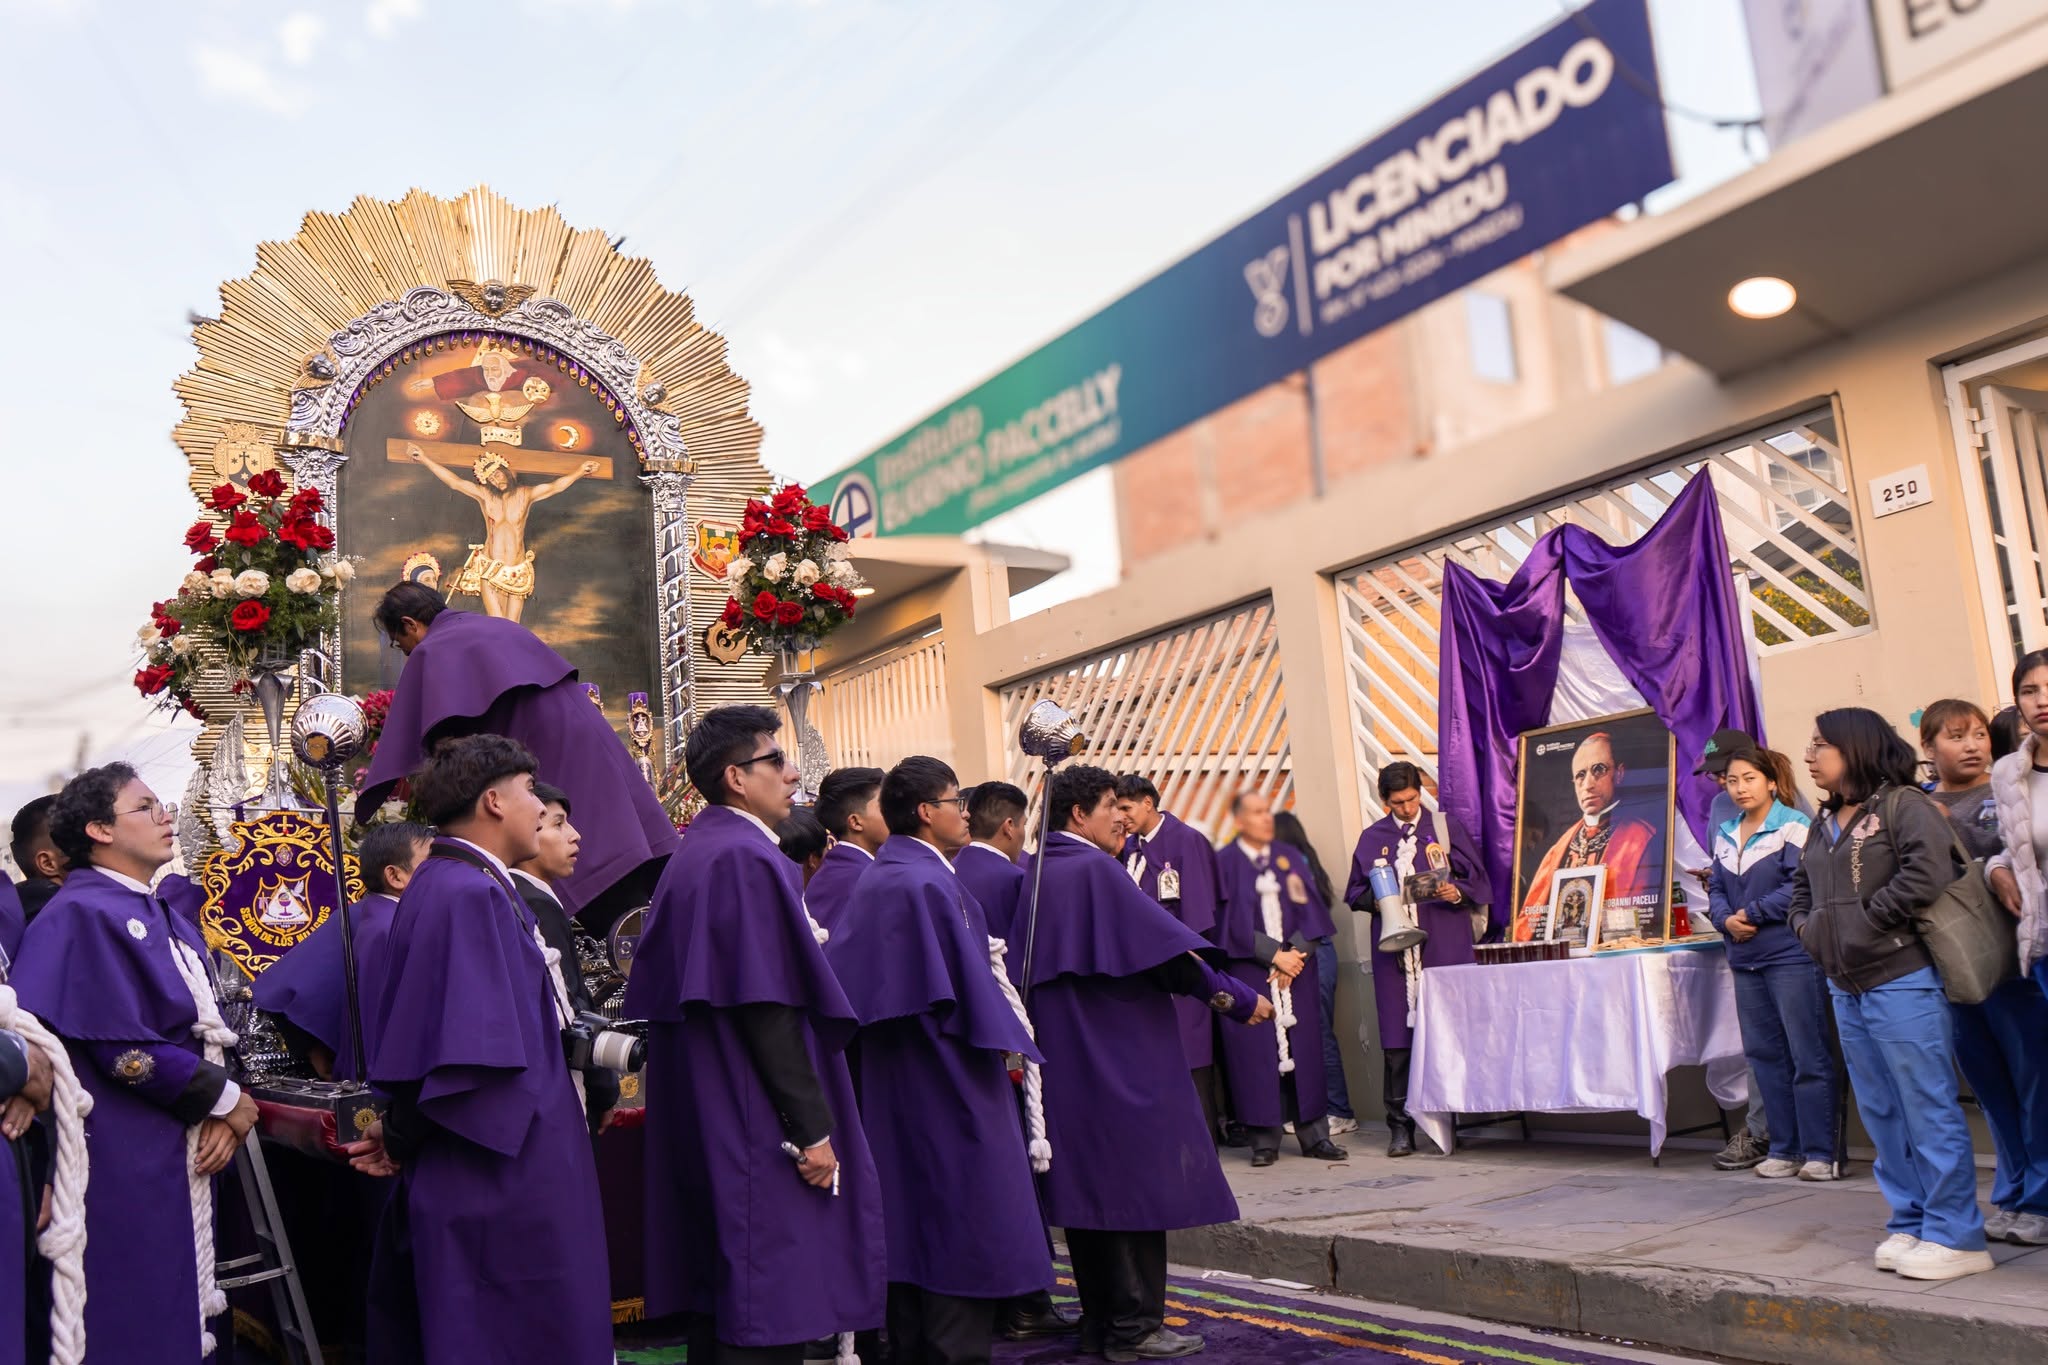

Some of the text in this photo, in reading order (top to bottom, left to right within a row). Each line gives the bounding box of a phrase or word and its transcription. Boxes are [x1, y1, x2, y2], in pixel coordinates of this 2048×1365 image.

[1308, 38, 1614, 255] LICENCIADO
[1313, 234, 1382, 299] POR
[1379, 163, 1508, 264] MINEDU
[1883, 480, 1918, 502] 250
[1632, 893, 1658, 906] PACELLI
[240, 907, 262, 936] SEÑOR
[260, 931, 274, 944] DE
[274, 936, 293, 946] LOS
